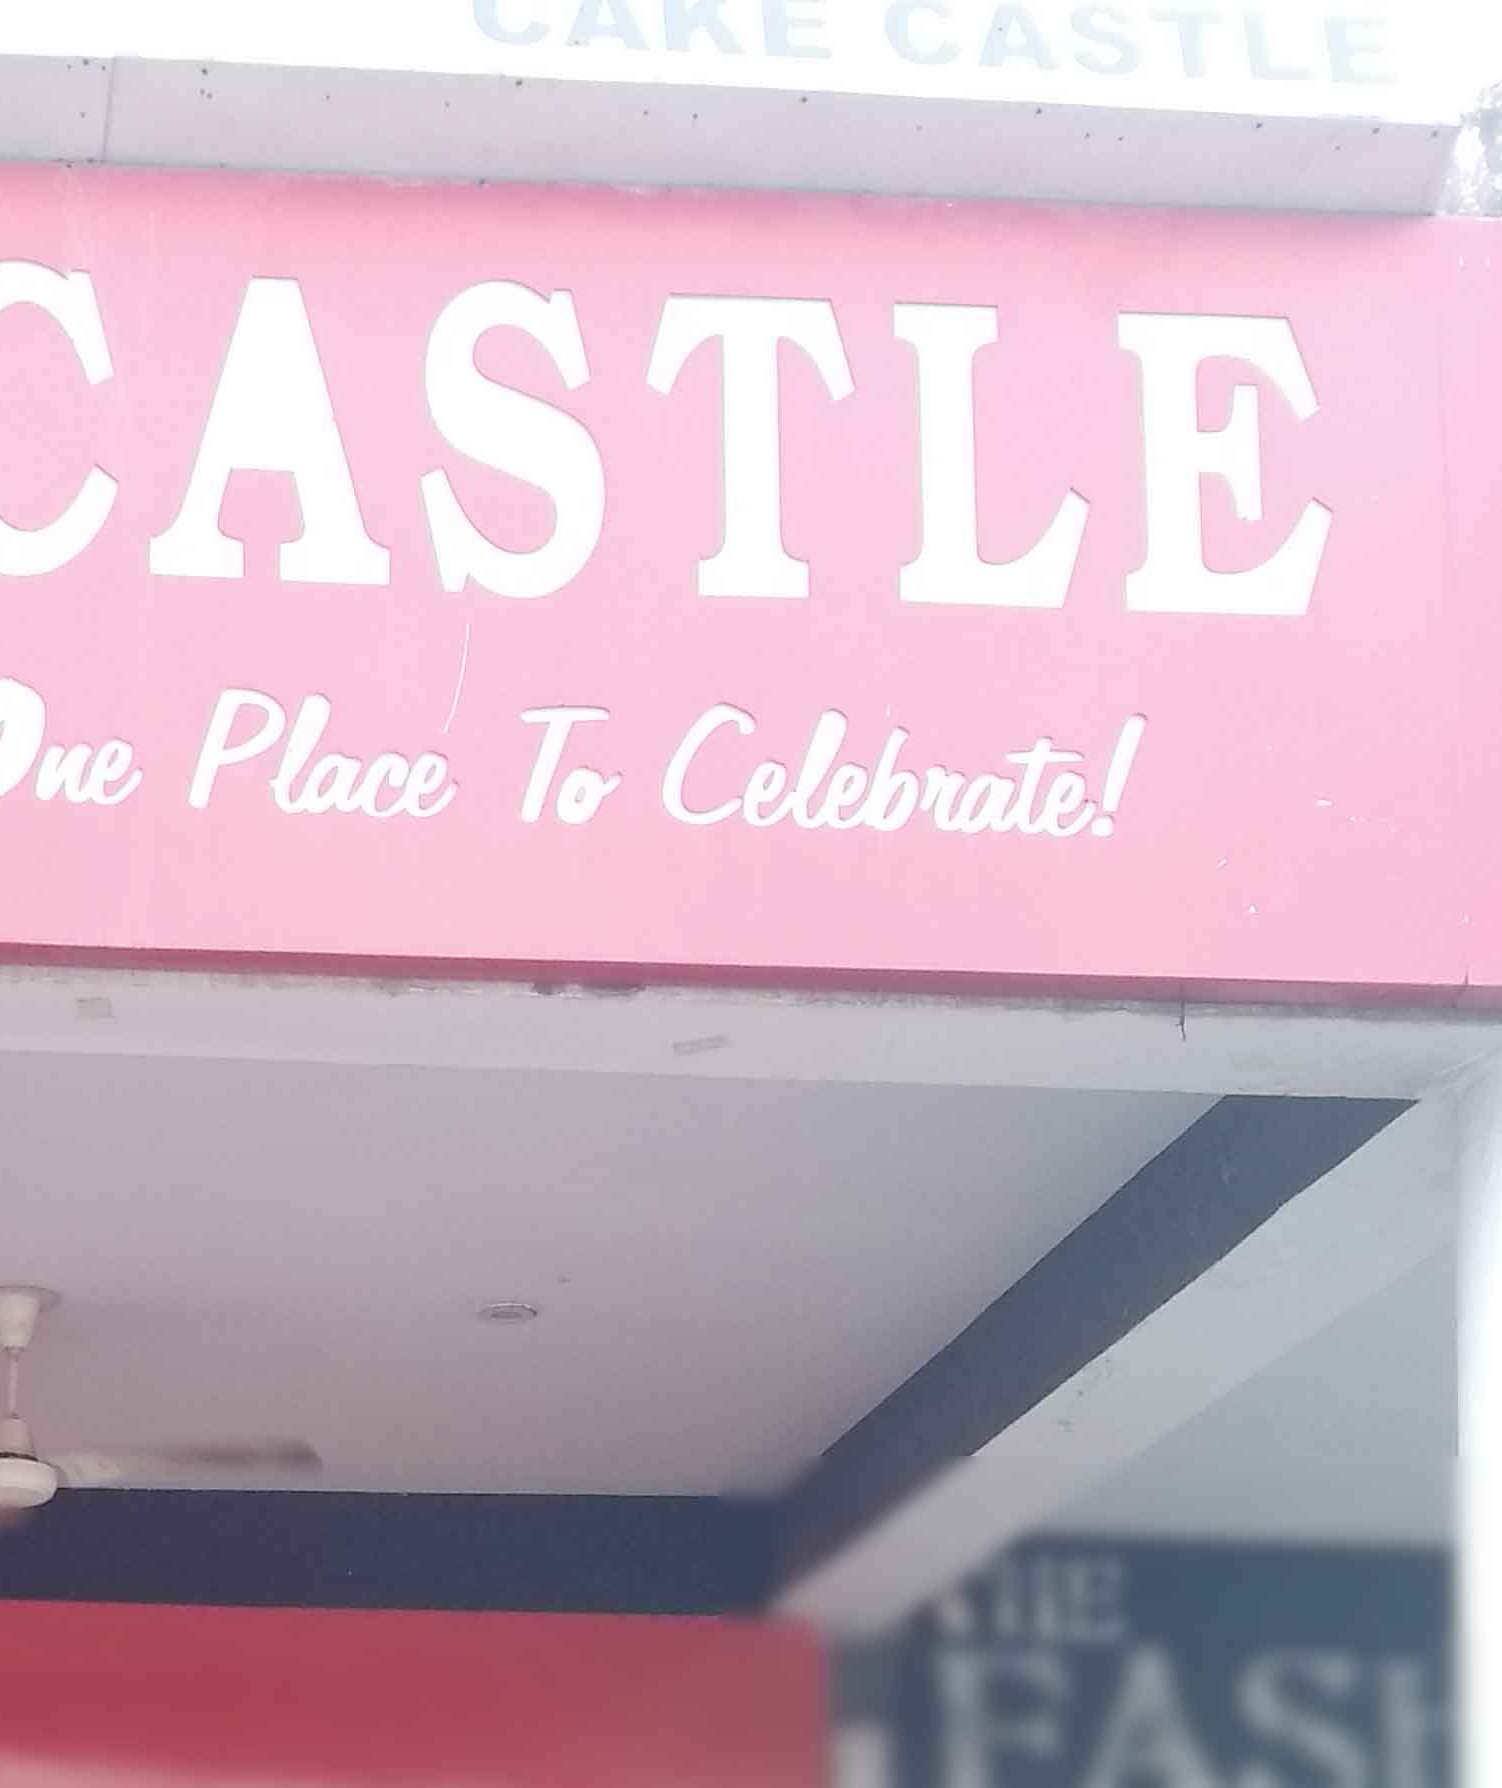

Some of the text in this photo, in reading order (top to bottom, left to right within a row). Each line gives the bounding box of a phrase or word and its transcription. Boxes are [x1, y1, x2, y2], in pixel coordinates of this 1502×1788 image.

[472, 0, 1399, 85] CAKE CASTLE
[188, 686, 458, 819] Place
[519, 703, 621, 825] To
[660, 700, 1148, 840] Celebrate!
